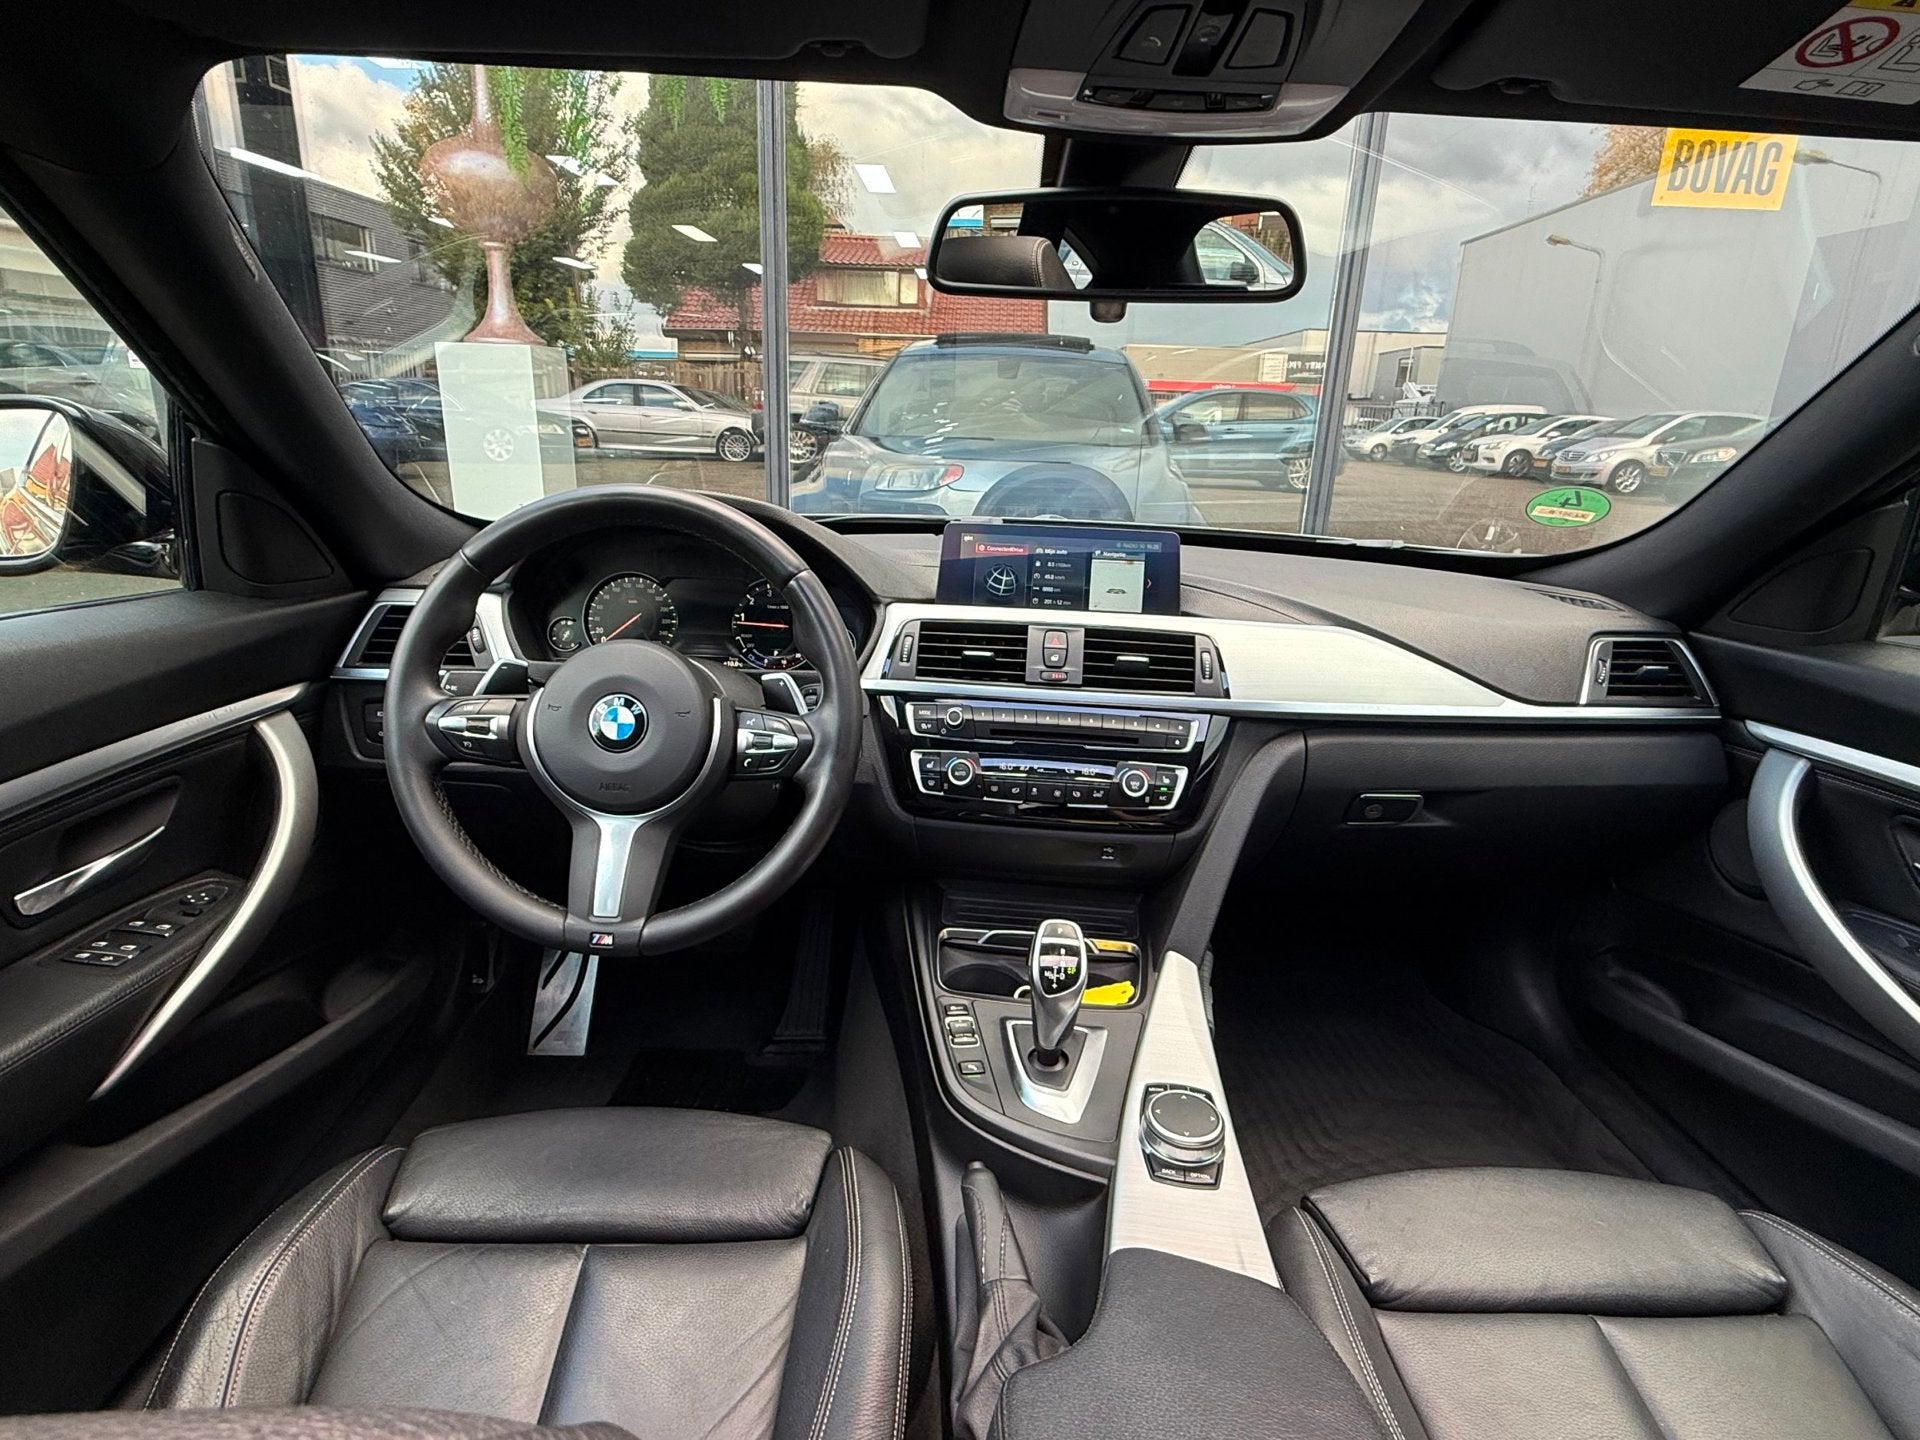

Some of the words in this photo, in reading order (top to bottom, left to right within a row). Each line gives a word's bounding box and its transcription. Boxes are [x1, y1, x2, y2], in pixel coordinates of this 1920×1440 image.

[1666, 138, 1784, 196] BOVAG
[986, 545, 1024, 553] ConnectedDrive
[767, 589, 772, 597] 3
[749, 597, 755, 605] 2
[740, 612, 745, 621] 1
[596, 626, 604, 634] 20
[596, 697, 642, 716] BMW
[1190, 1172, 1211, 1180] OPTION
